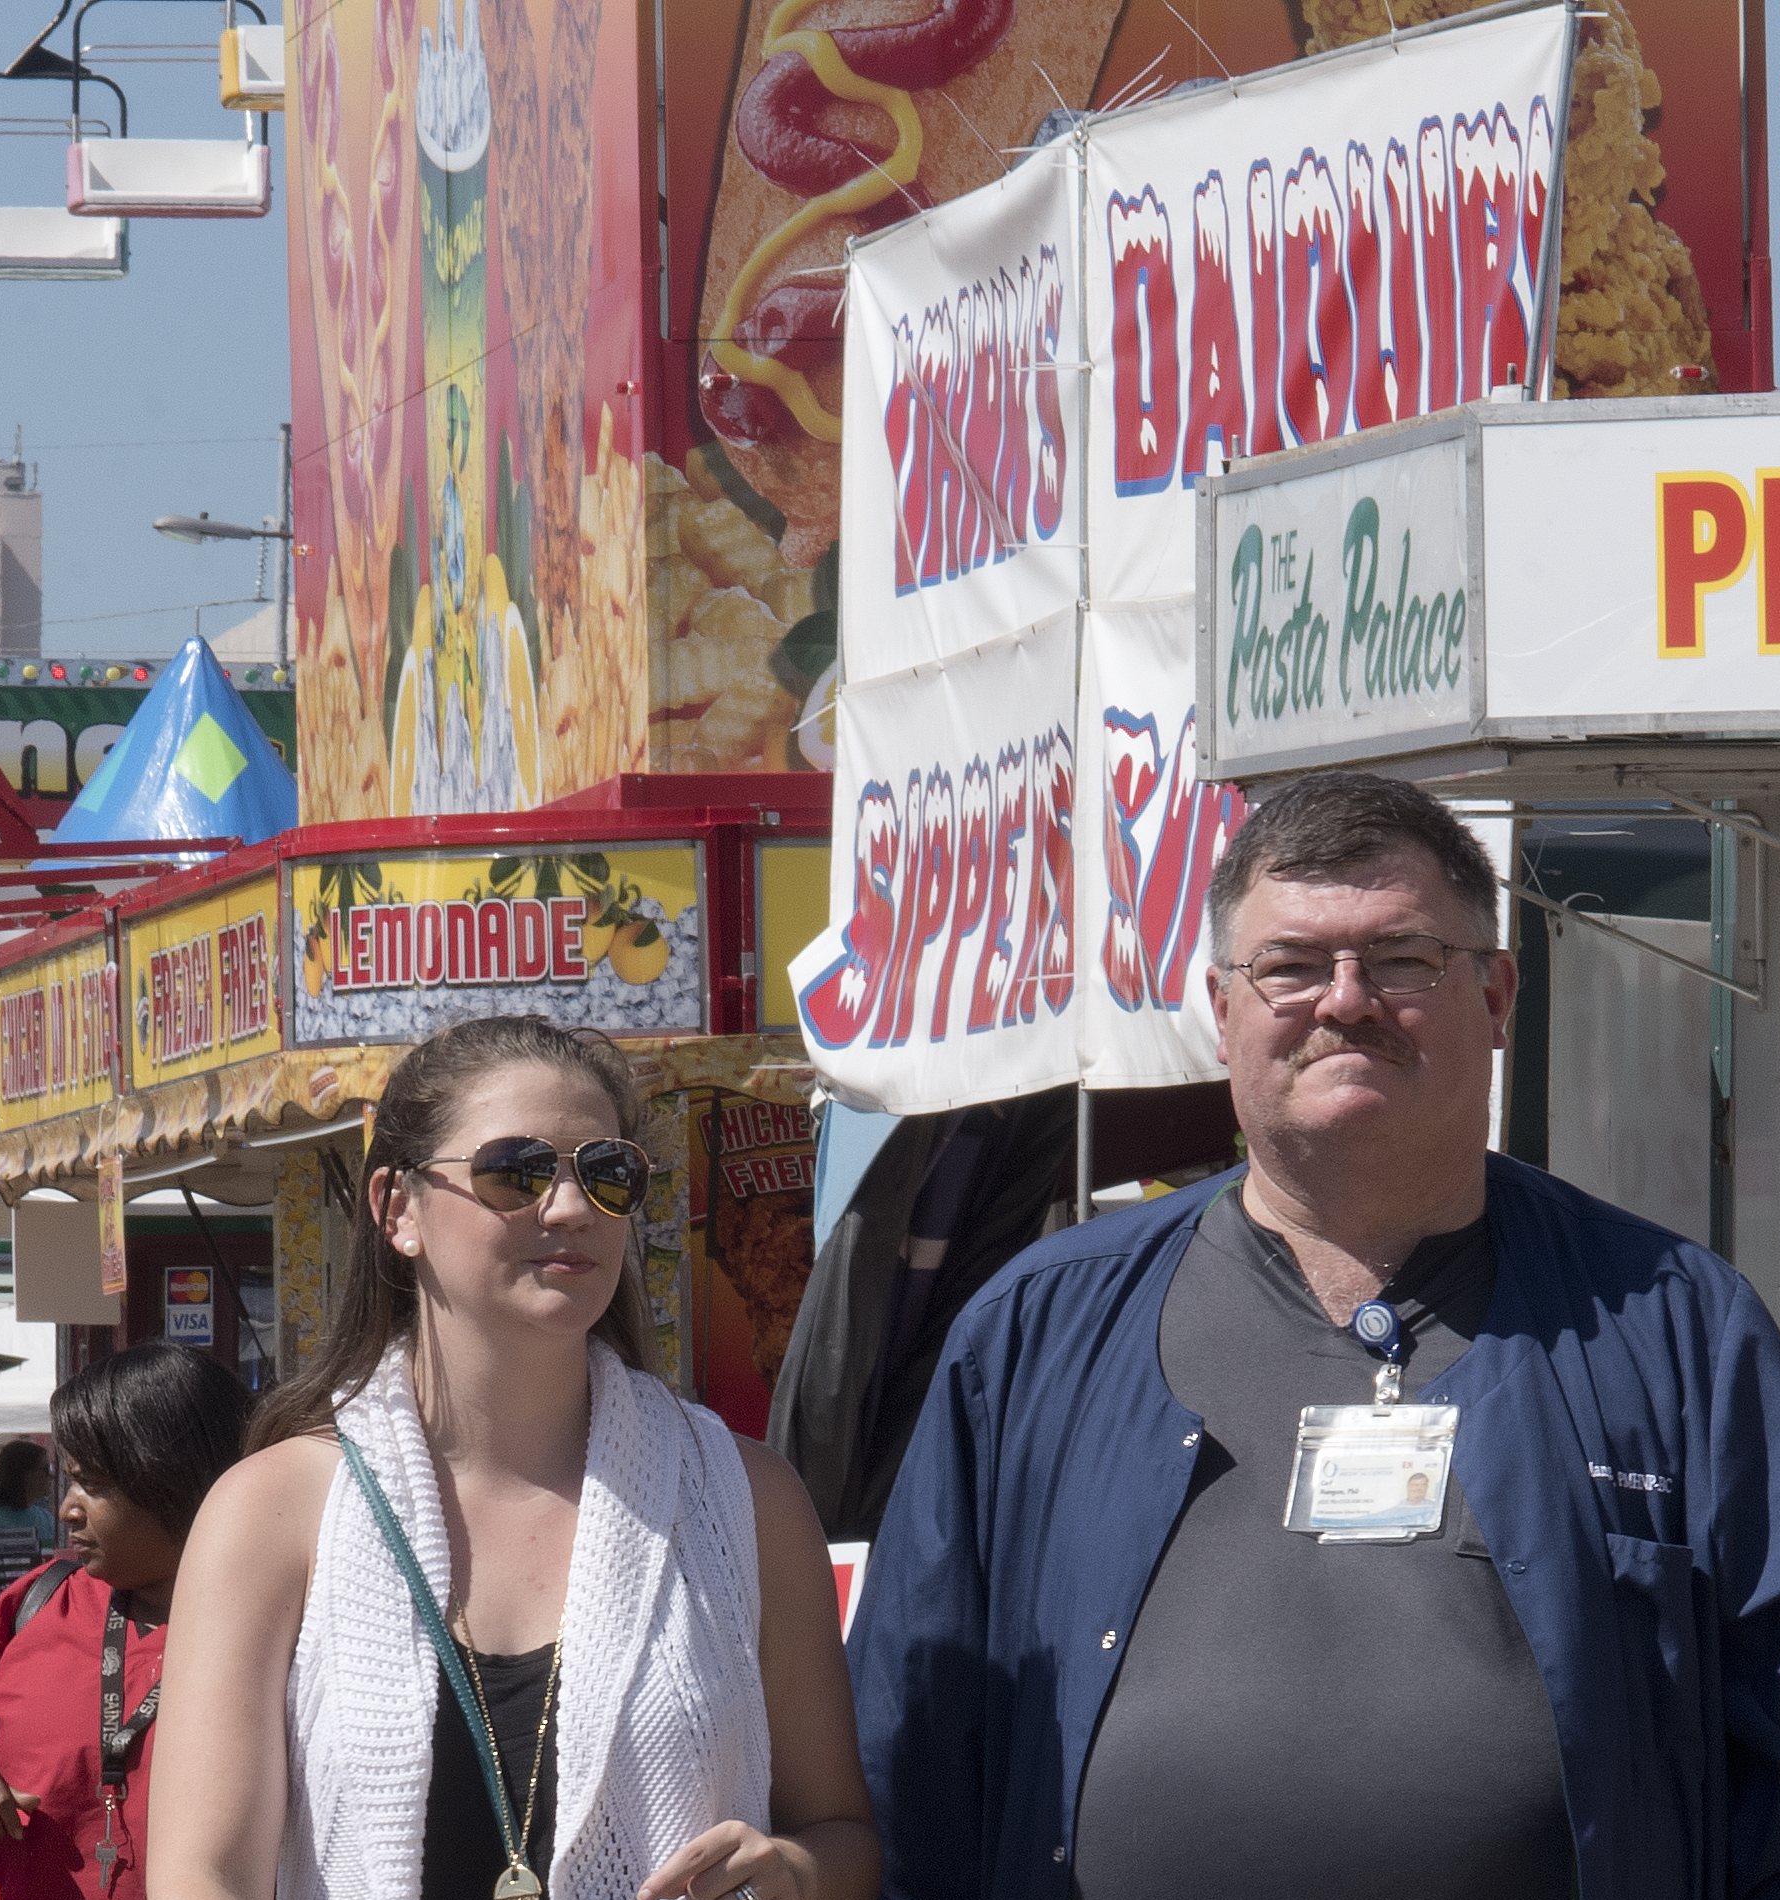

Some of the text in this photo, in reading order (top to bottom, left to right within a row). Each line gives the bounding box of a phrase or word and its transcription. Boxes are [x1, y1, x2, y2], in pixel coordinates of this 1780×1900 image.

[1270, 529, 1298, 594] THE
[1226, 496, 1467, 729] Pasta Palace
[330, 897, 588, 990] LEMONADE
[149, 930, 215, 1069] FRENCH
[217, 908, 270, 1051] FRIES
[173, 1313, 209, 1331] VISA
[102, 1692, 121, 1747] SAINTS
